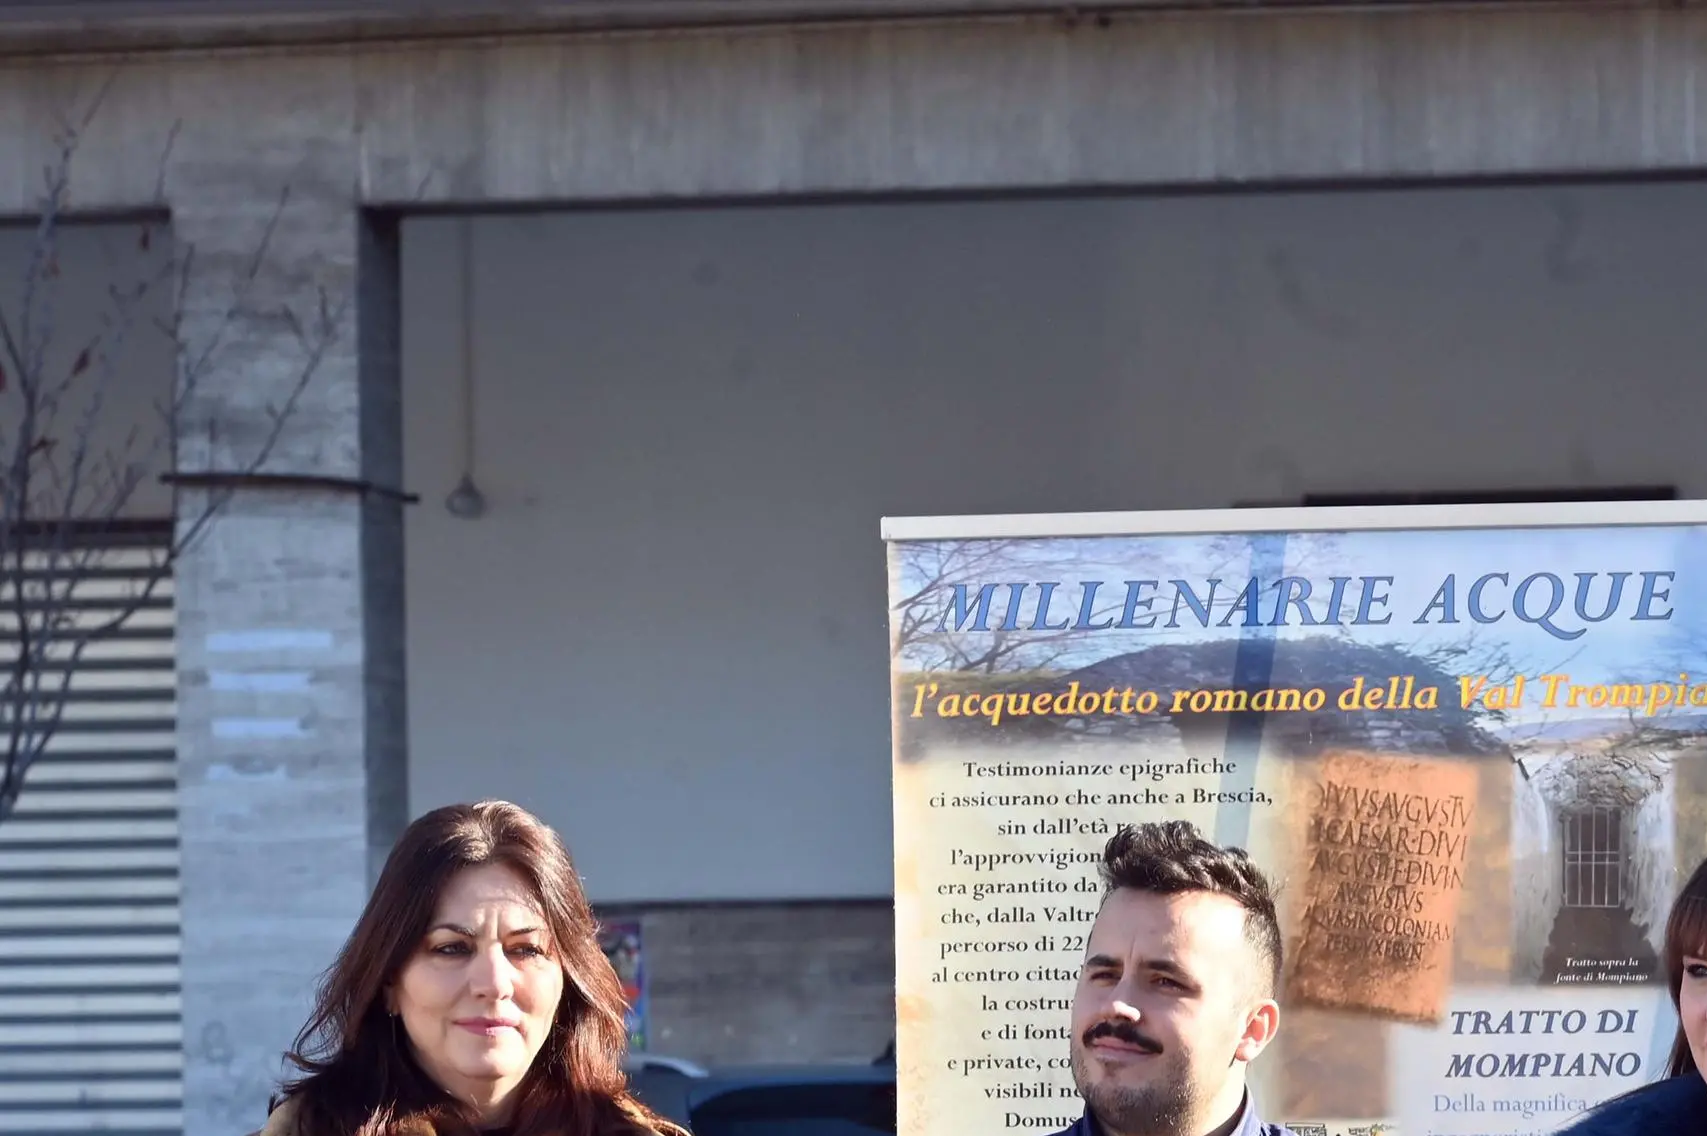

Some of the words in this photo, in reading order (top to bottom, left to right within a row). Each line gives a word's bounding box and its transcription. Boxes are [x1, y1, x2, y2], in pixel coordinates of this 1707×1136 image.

[935, 574, 1394, 634] MILLENARIE
[1414, 570, 1676, 640] ACQUE
[910, 682, 1157, 725] l’acquedotto
[1169, 686, 1326, 715] romano
[1337, 675, 1439, 711] della
[1457, 672, 1523, 709] Val
[963, 761, 1112, 777] Testimonianze
[1119, 758, 1236, 782] epigrafiche
[951, 792, 1059, 807] assicurano
[1065, 789, 1101, 806] che
[1107, 788, 1168, 805] anche
[1192, 787, 1273, 807] Brescia,
[997, 820, 1026, 835] sin
[951, 850, 1101, 874] l’approvvigion
[937, 882, 967, 895] era
[973, 878, 1068, 901] garantito
[1073, 876, 1098, 893] da
[940, 908, 981, 926] che,
[987, 906, 1036, 923] dalla
[940, 937, 1028, 960] percorso
[1035, 935, 1056, 951] di
[1061, 936, 1083, 951] 22
[1566, 957, 1597, 967] Tratto
[932, 967, 948, 983] al
[954, 968, 1020, 982] centro
[981, 995, 998, 1011] la
[998, 1023, 1018, 1040] di
[1450, 1010, 1587, 1035] TRATTO
[1595, 1009, 1639, 1034] DI
[963, 1053, 1042, 1075] private,
[1445, 1052, 1641, 1078] MOMPIANO
[984, 1082, 1052, 1099] visibili
[1433, 1092, 1485, 1113] Della
[1492, 1092, 1587, 1118] magnifica
[1004, 1112, 1077, 1129] Domus
